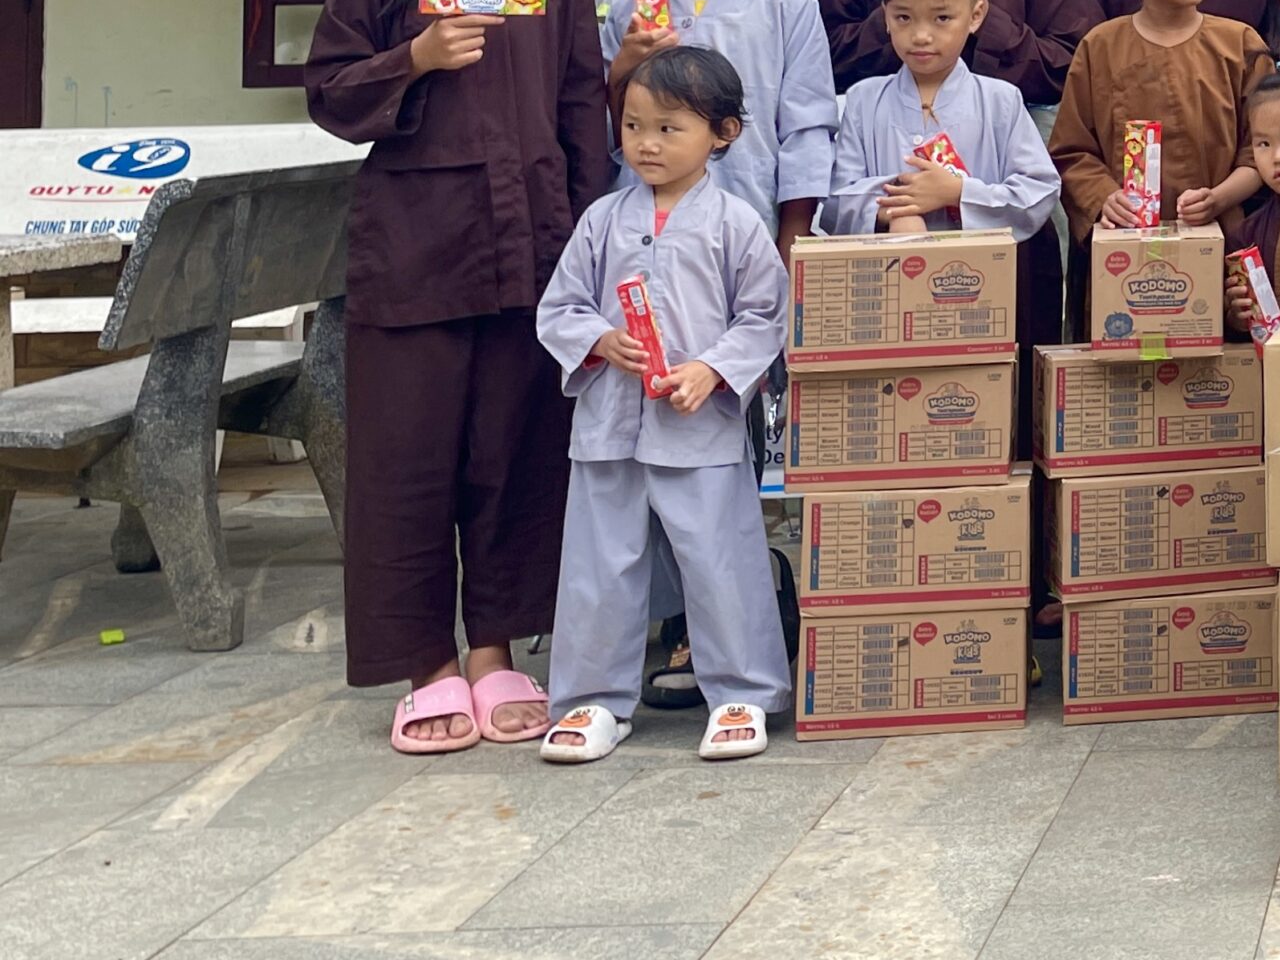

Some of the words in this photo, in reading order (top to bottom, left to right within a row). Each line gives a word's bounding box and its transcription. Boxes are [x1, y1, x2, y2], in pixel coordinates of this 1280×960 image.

[25, 221, 65, 234] CHUNG
[70, 221, 88, 234] TAY
[91, 218, 114, 233] GÓP
[932, 275, 980, 288] KODOMO
[1128, 280, 1186, 295] KODOMO
[1185, 380, 1229, 392] KODOMO
[929, 395, 976, 408] KODOMO
[1201, 492, 1245, 505] KODOMO
[948, 509, 994, 522] KODOMO
[944, 631, 991, 644] KODOMO
